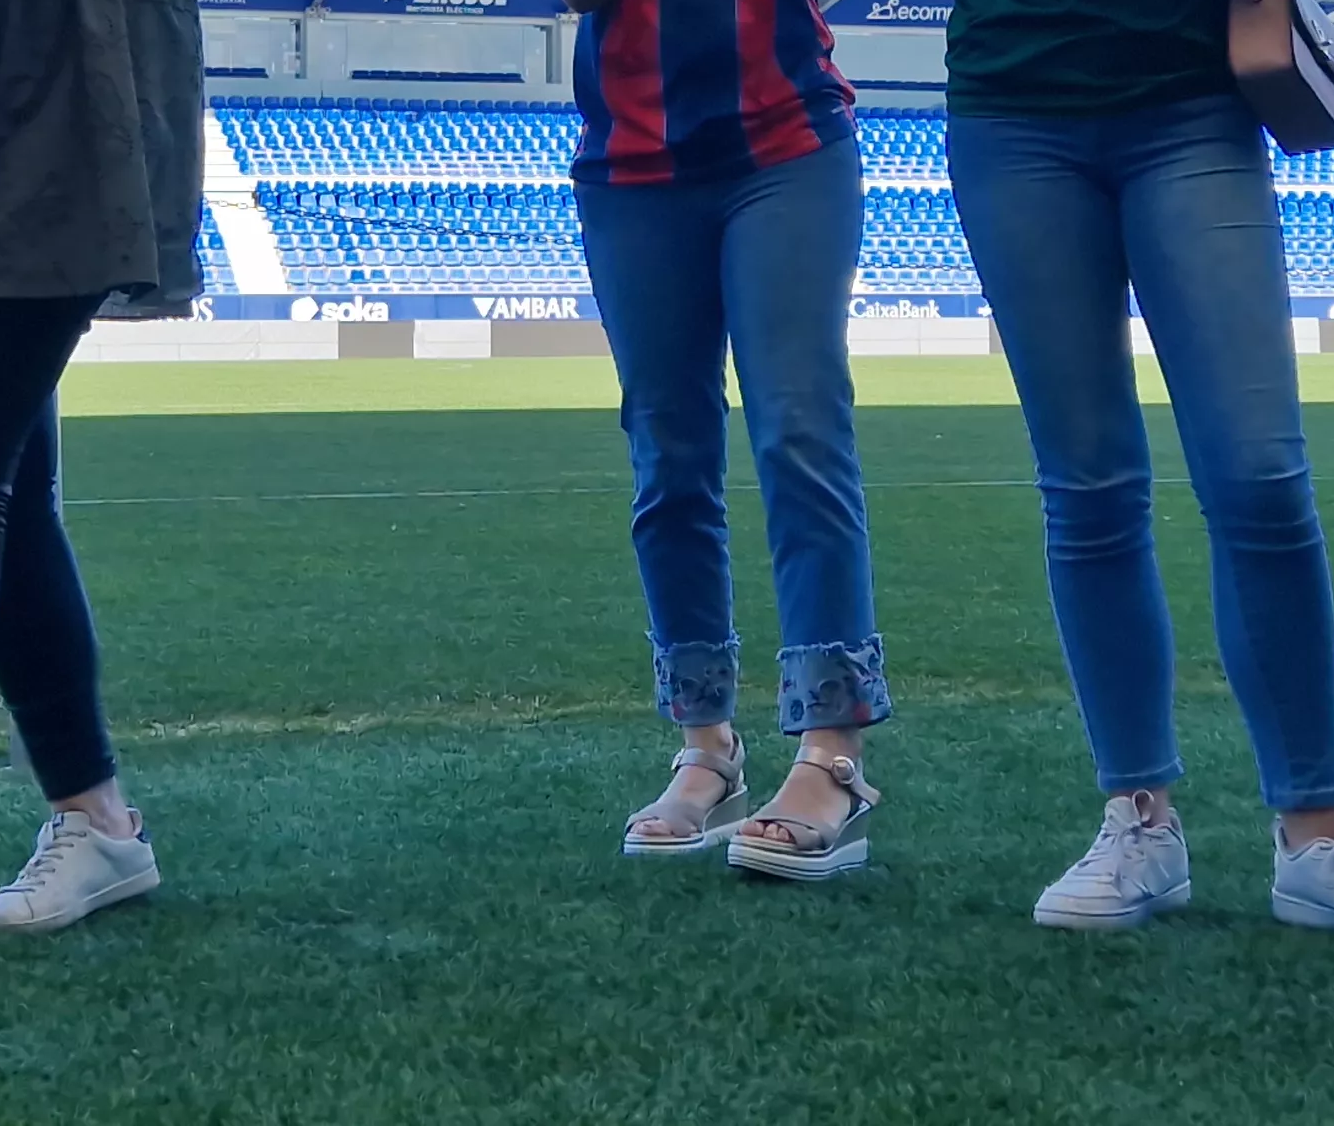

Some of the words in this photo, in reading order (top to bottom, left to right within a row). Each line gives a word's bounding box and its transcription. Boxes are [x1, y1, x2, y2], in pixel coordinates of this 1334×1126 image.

[321, 295, 389, 321] soka
[492, 297, 579, 319] AMBAR
[849, 297, 941, 319] CaixaBank
